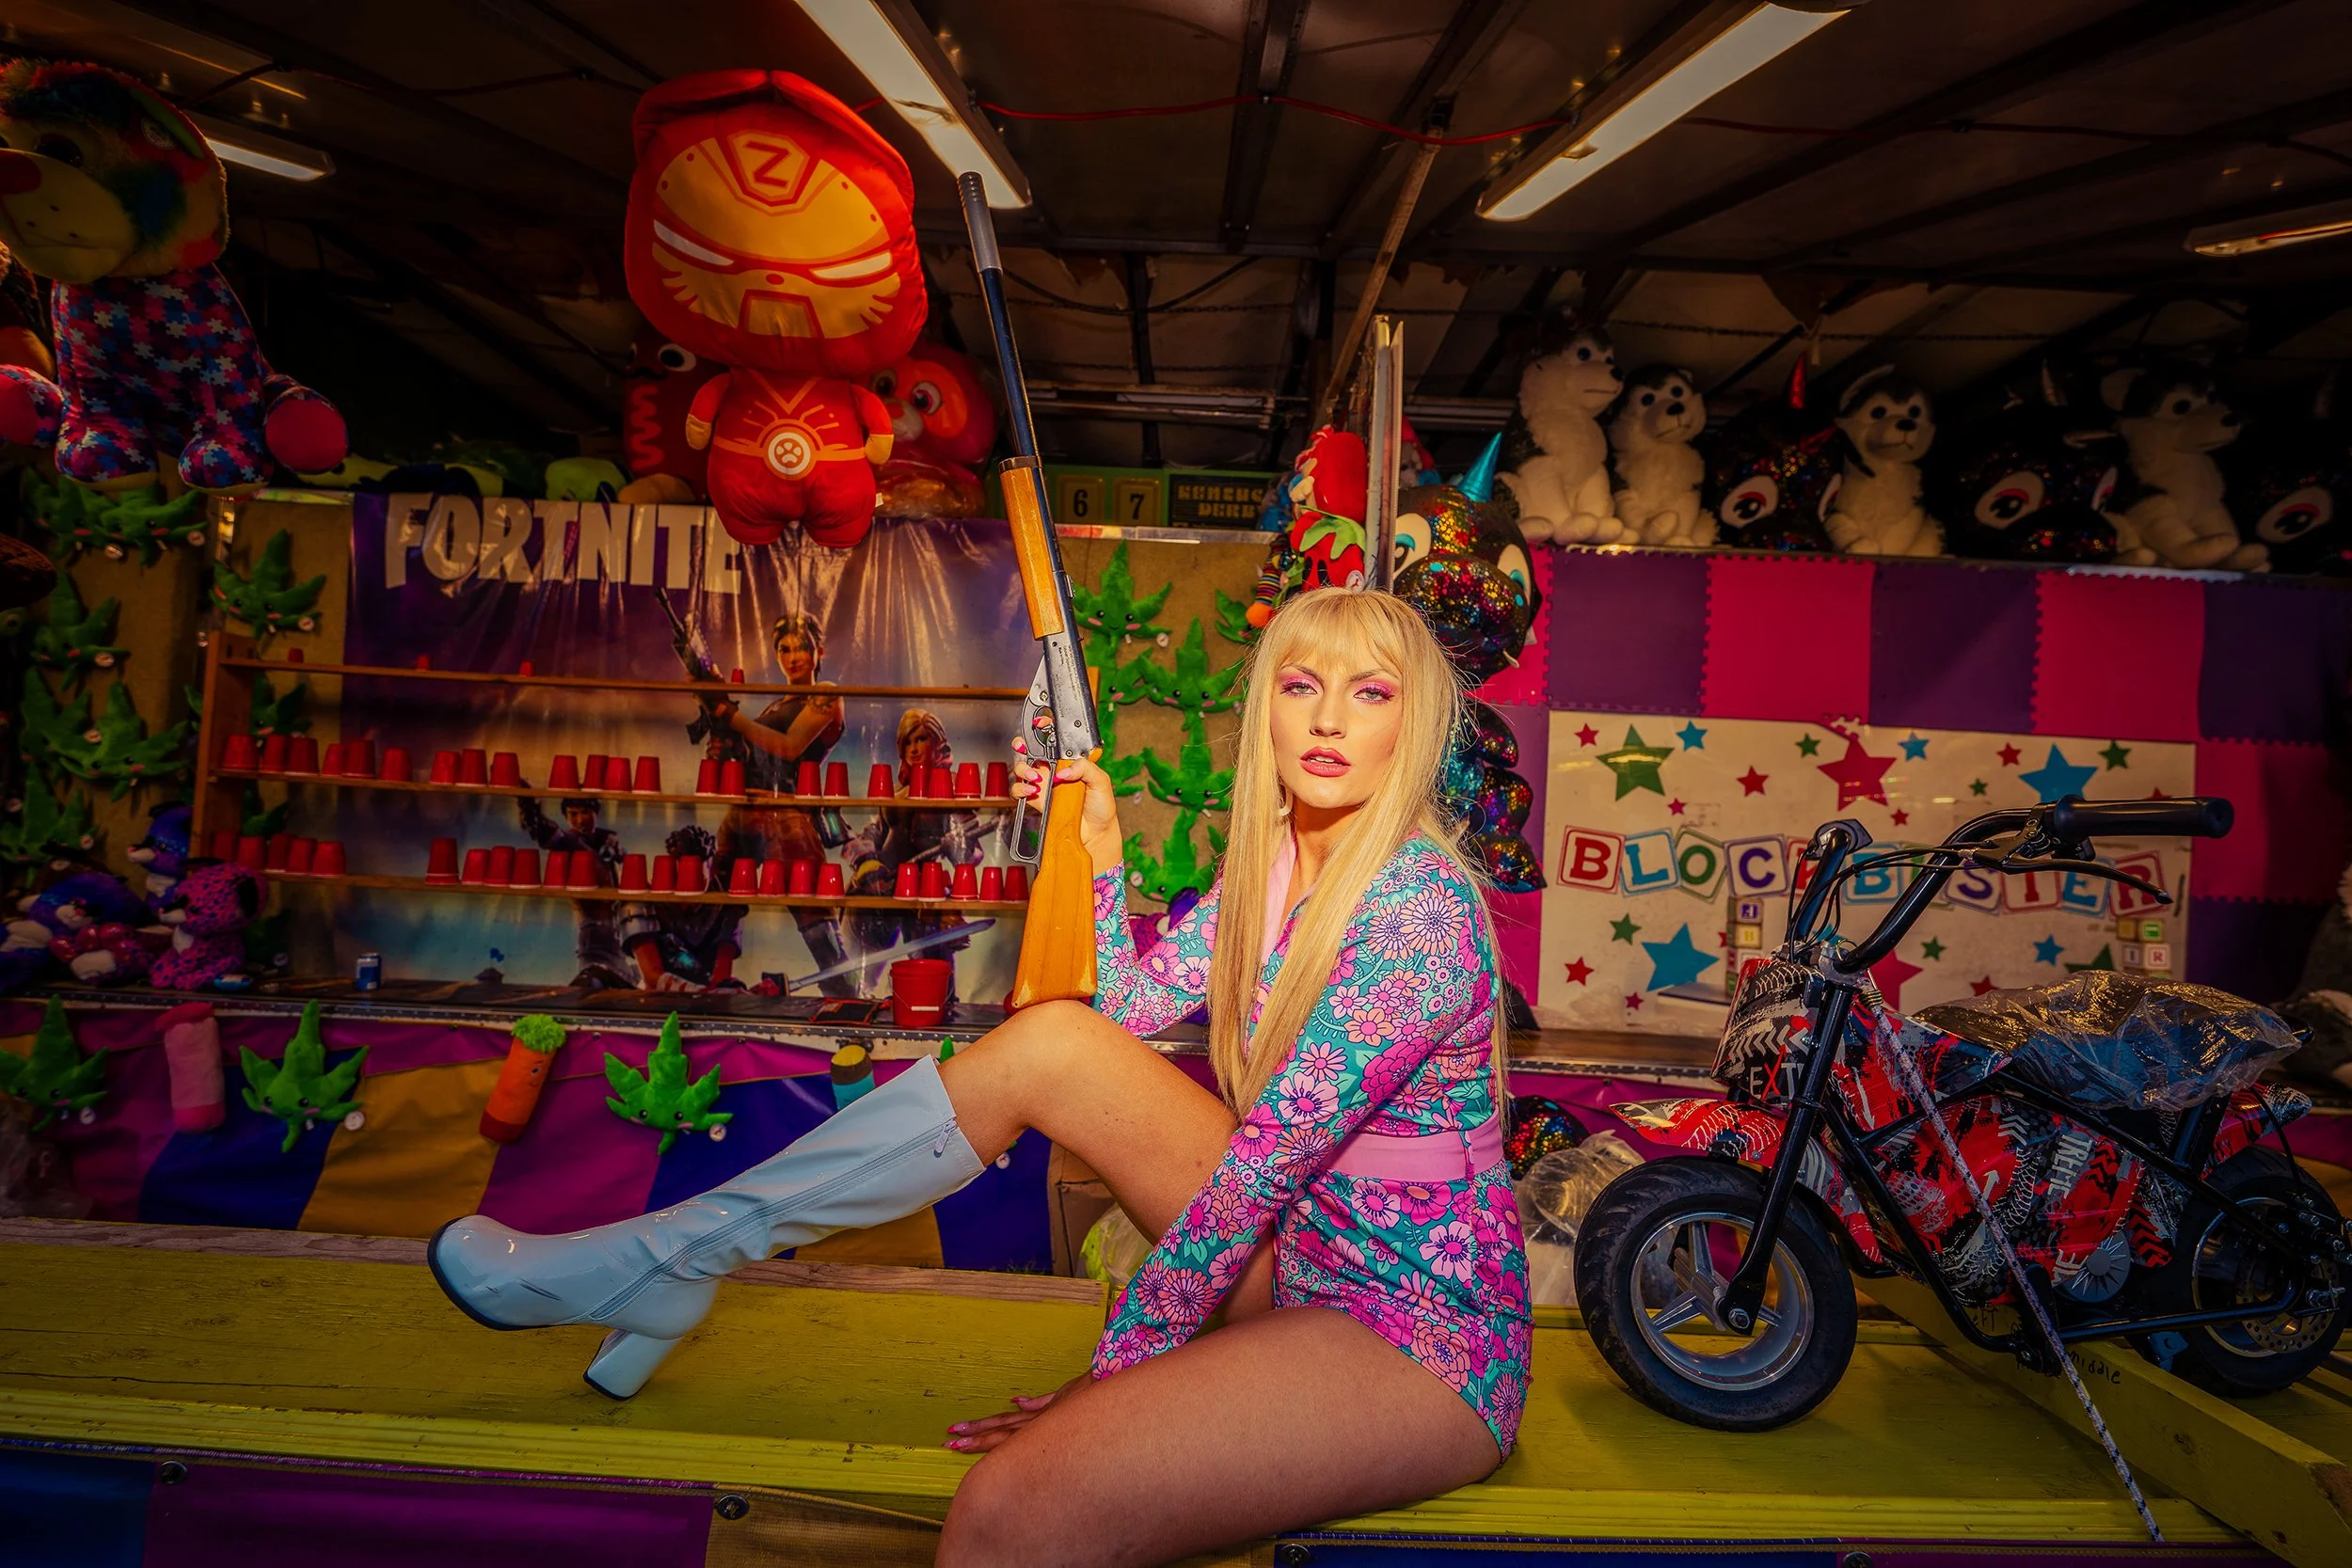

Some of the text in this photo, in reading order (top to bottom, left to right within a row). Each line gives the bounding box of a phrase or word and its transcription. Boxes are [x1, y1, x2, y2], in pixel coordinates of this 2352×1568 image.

[744, 140, 791, 188] Z
[1073, 488, 1146, 520] 6 7
[1177, 484, 1265, 503] KENTUC
[1198, 501, 1263, 519] DERB
[384, 491, 743, 594] FORTNITE
[1568, 836, 2160, 911] BLOCKBSER
[1749, 1044, 1804, 1101] EXT
